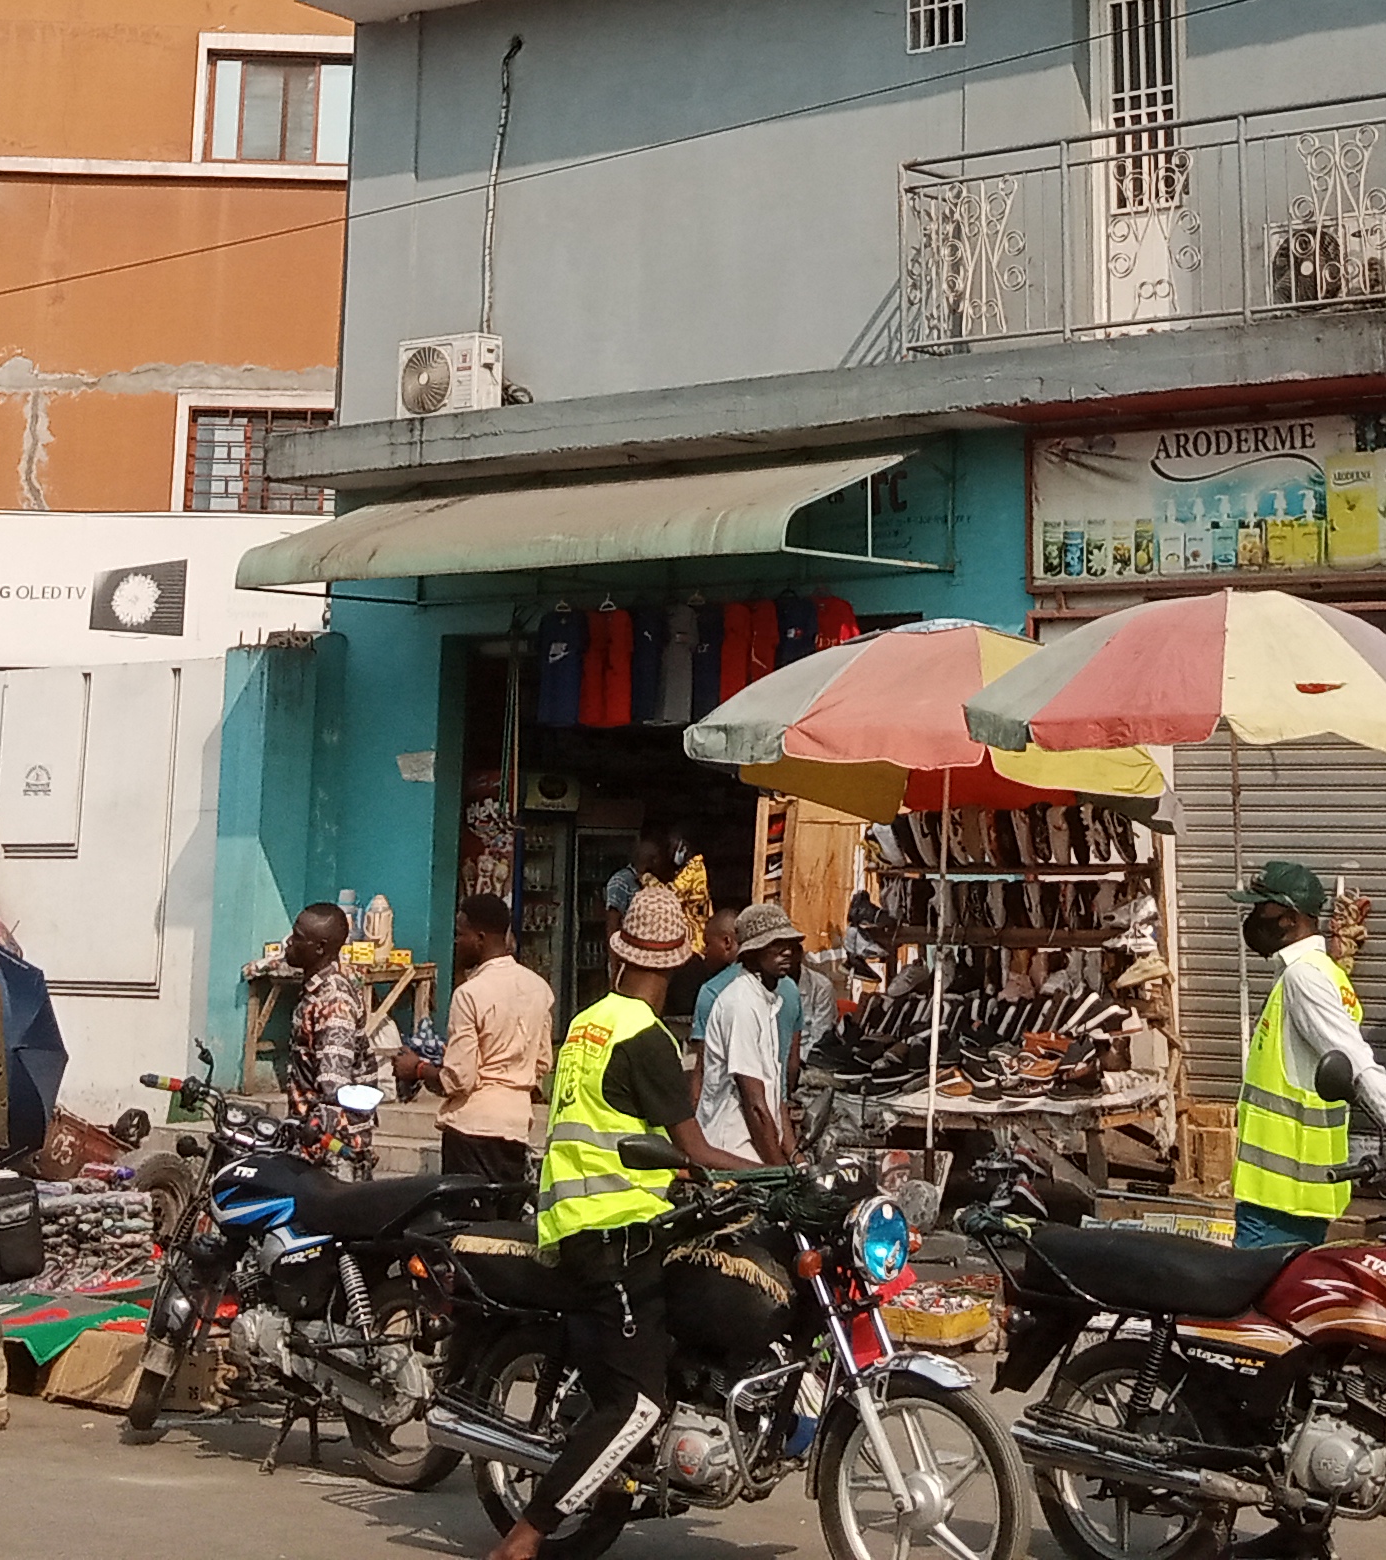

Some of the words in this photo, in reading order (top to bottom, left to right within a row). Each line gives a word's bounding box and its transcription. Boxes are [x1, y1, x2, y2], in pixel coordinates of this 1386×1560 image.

[1155, 422, 1316, 460] ARODERME
[16, 585, 62, 600] OLED
[65, 586, 87, 600] TV
[233, 1166, 258, 1178] TVS
